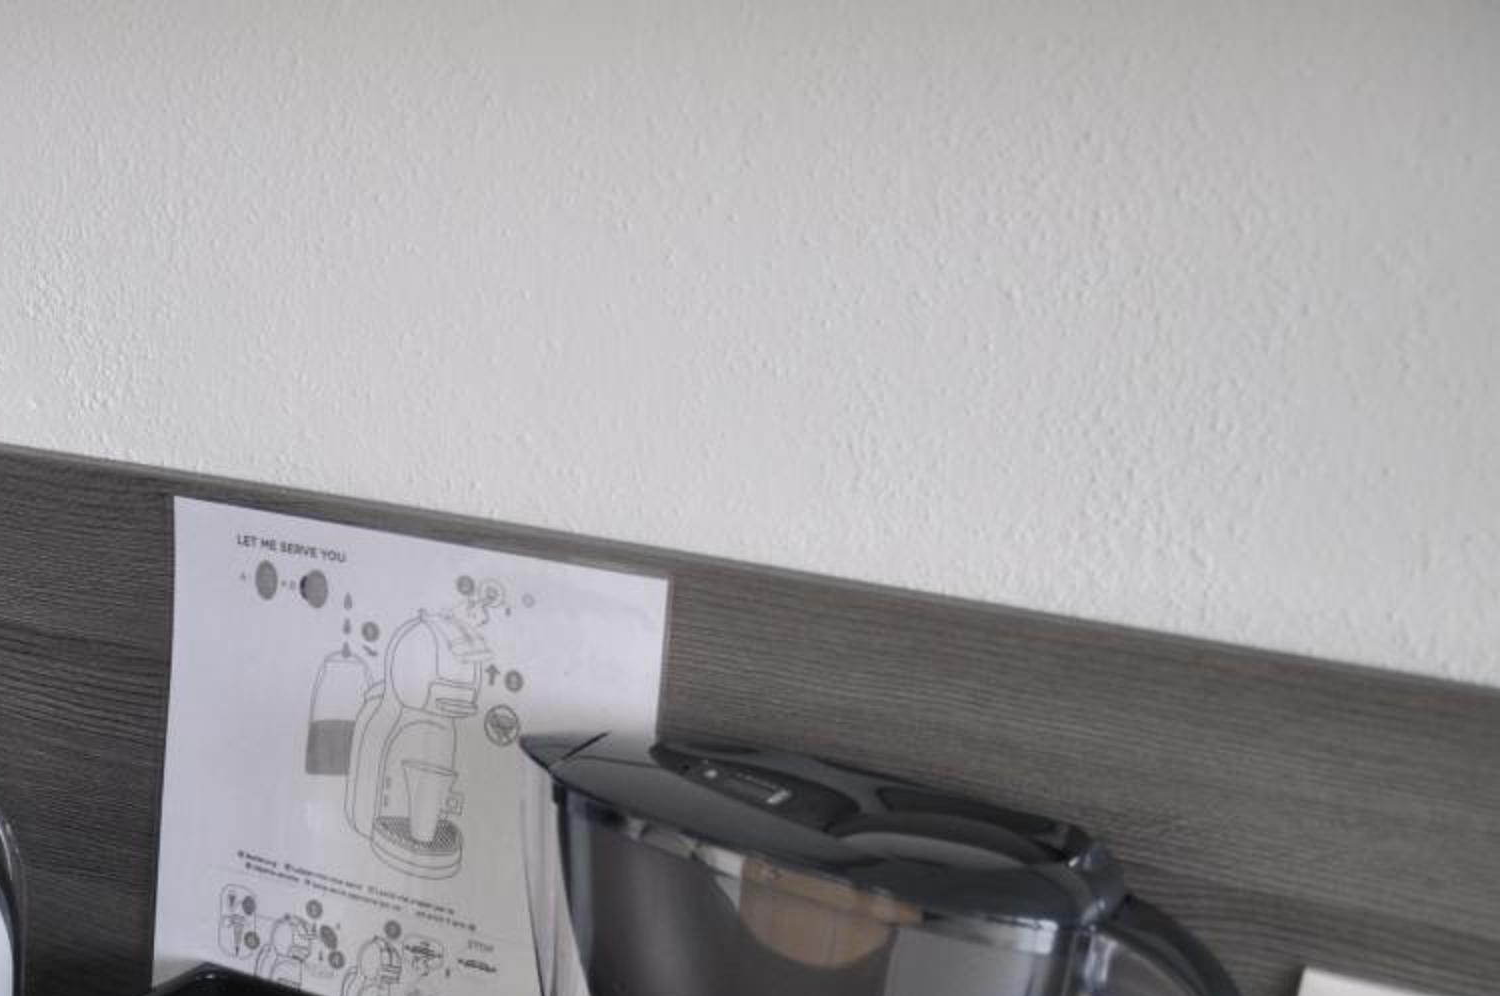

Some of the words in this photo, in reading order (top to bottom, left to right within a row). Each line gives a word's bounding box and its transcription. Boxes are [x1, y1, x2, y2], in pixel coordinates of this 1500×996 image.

[237, 533, 256, 548] LET
[261, 538, 277, 551] ME
[280, 541, 318, 559] SERVE
[321, 548, 347, 563] YOU
